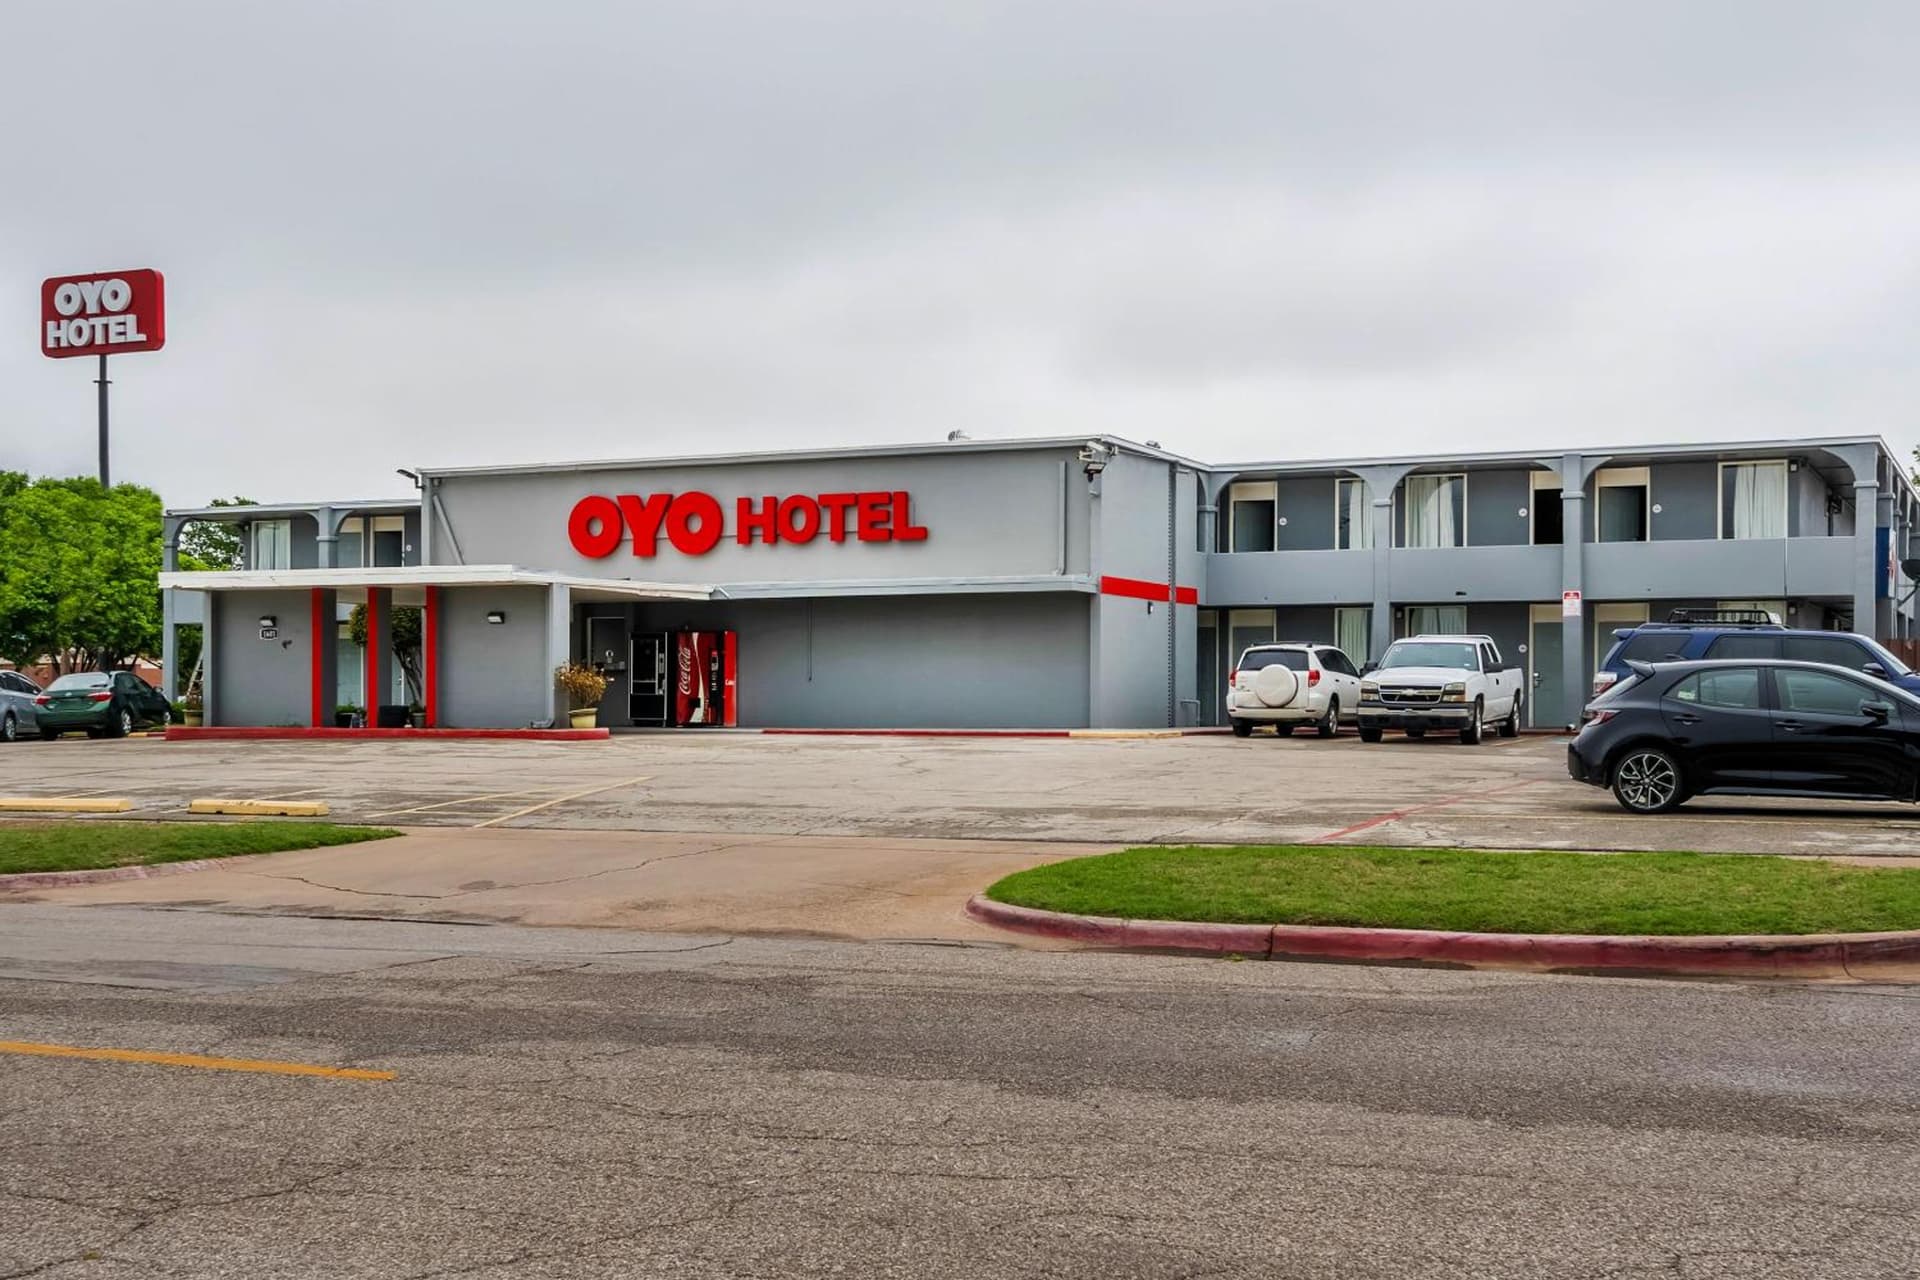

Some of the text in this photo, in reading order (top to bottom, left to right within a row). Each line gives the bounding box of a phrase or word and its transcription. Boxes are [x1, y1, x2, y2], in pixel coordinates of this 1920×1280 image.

[54, 278, 132, 316] OYO
[46, 314, 147, 349] HOTEL
[568, 491, 928, 559] OYO HOTEL
